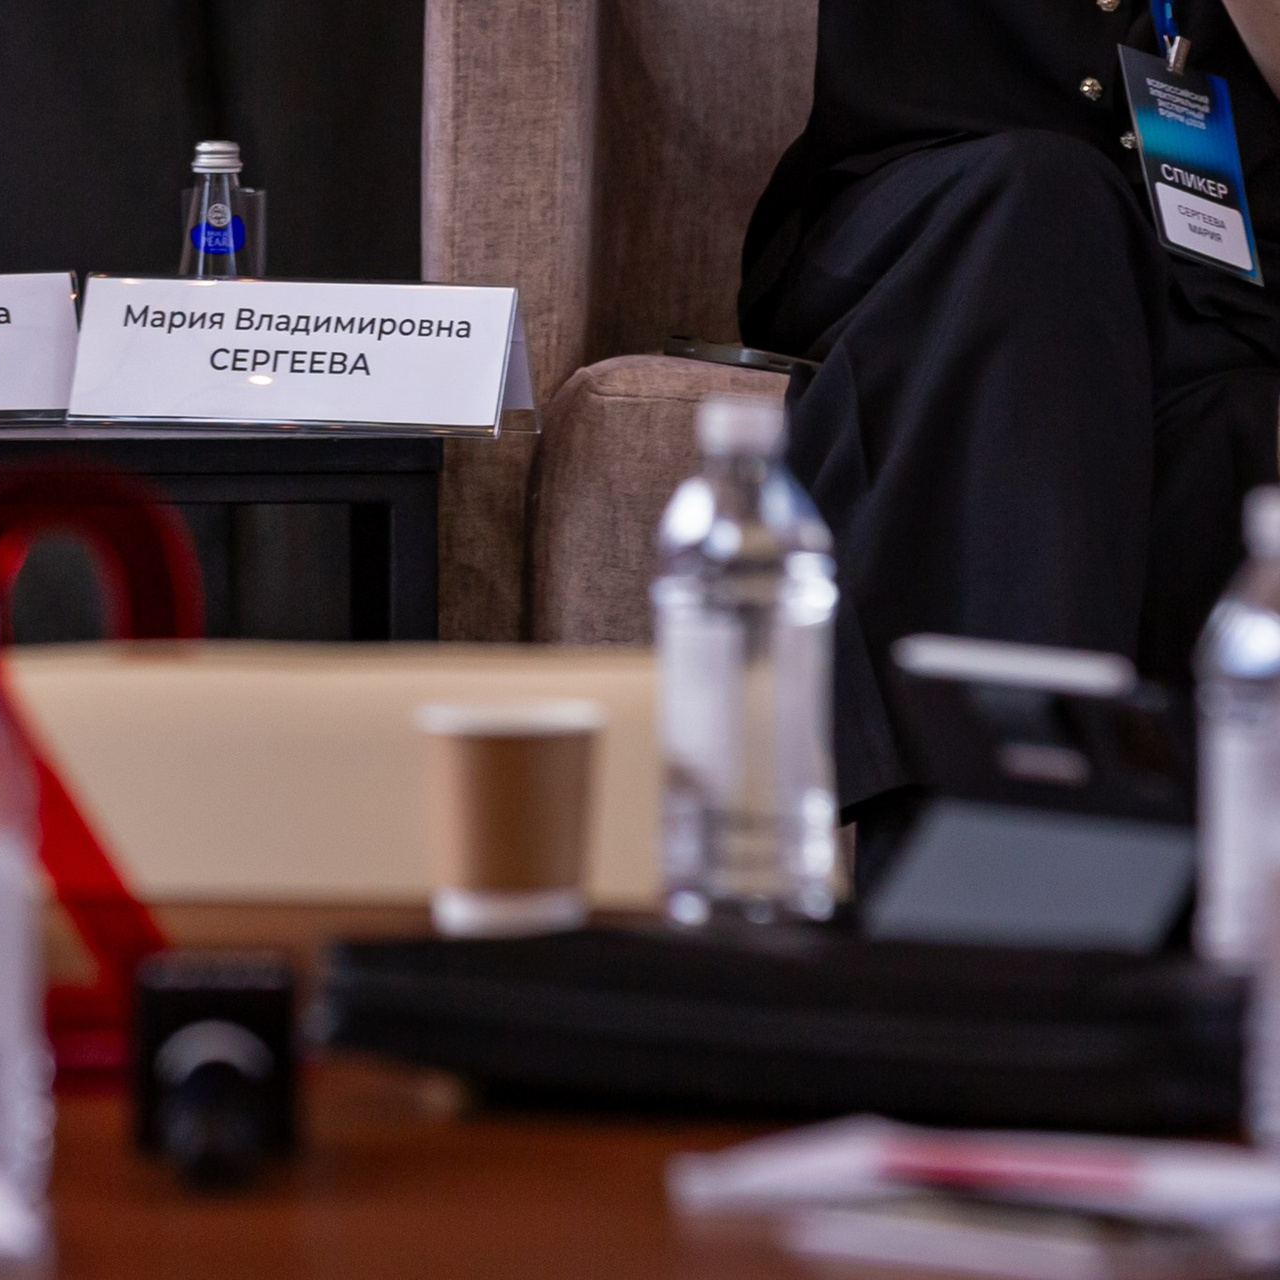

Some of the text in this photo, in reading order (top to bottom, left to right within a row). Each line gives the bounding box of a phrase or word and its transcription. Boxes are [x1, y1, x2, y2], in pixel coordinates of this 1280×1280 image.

[1161, 163, 1228, 199] СПИКЕР
[122, 304, 472, 341] Мария Владимировна
[209, 348, 371, 376] СЕРГЕЕВА
